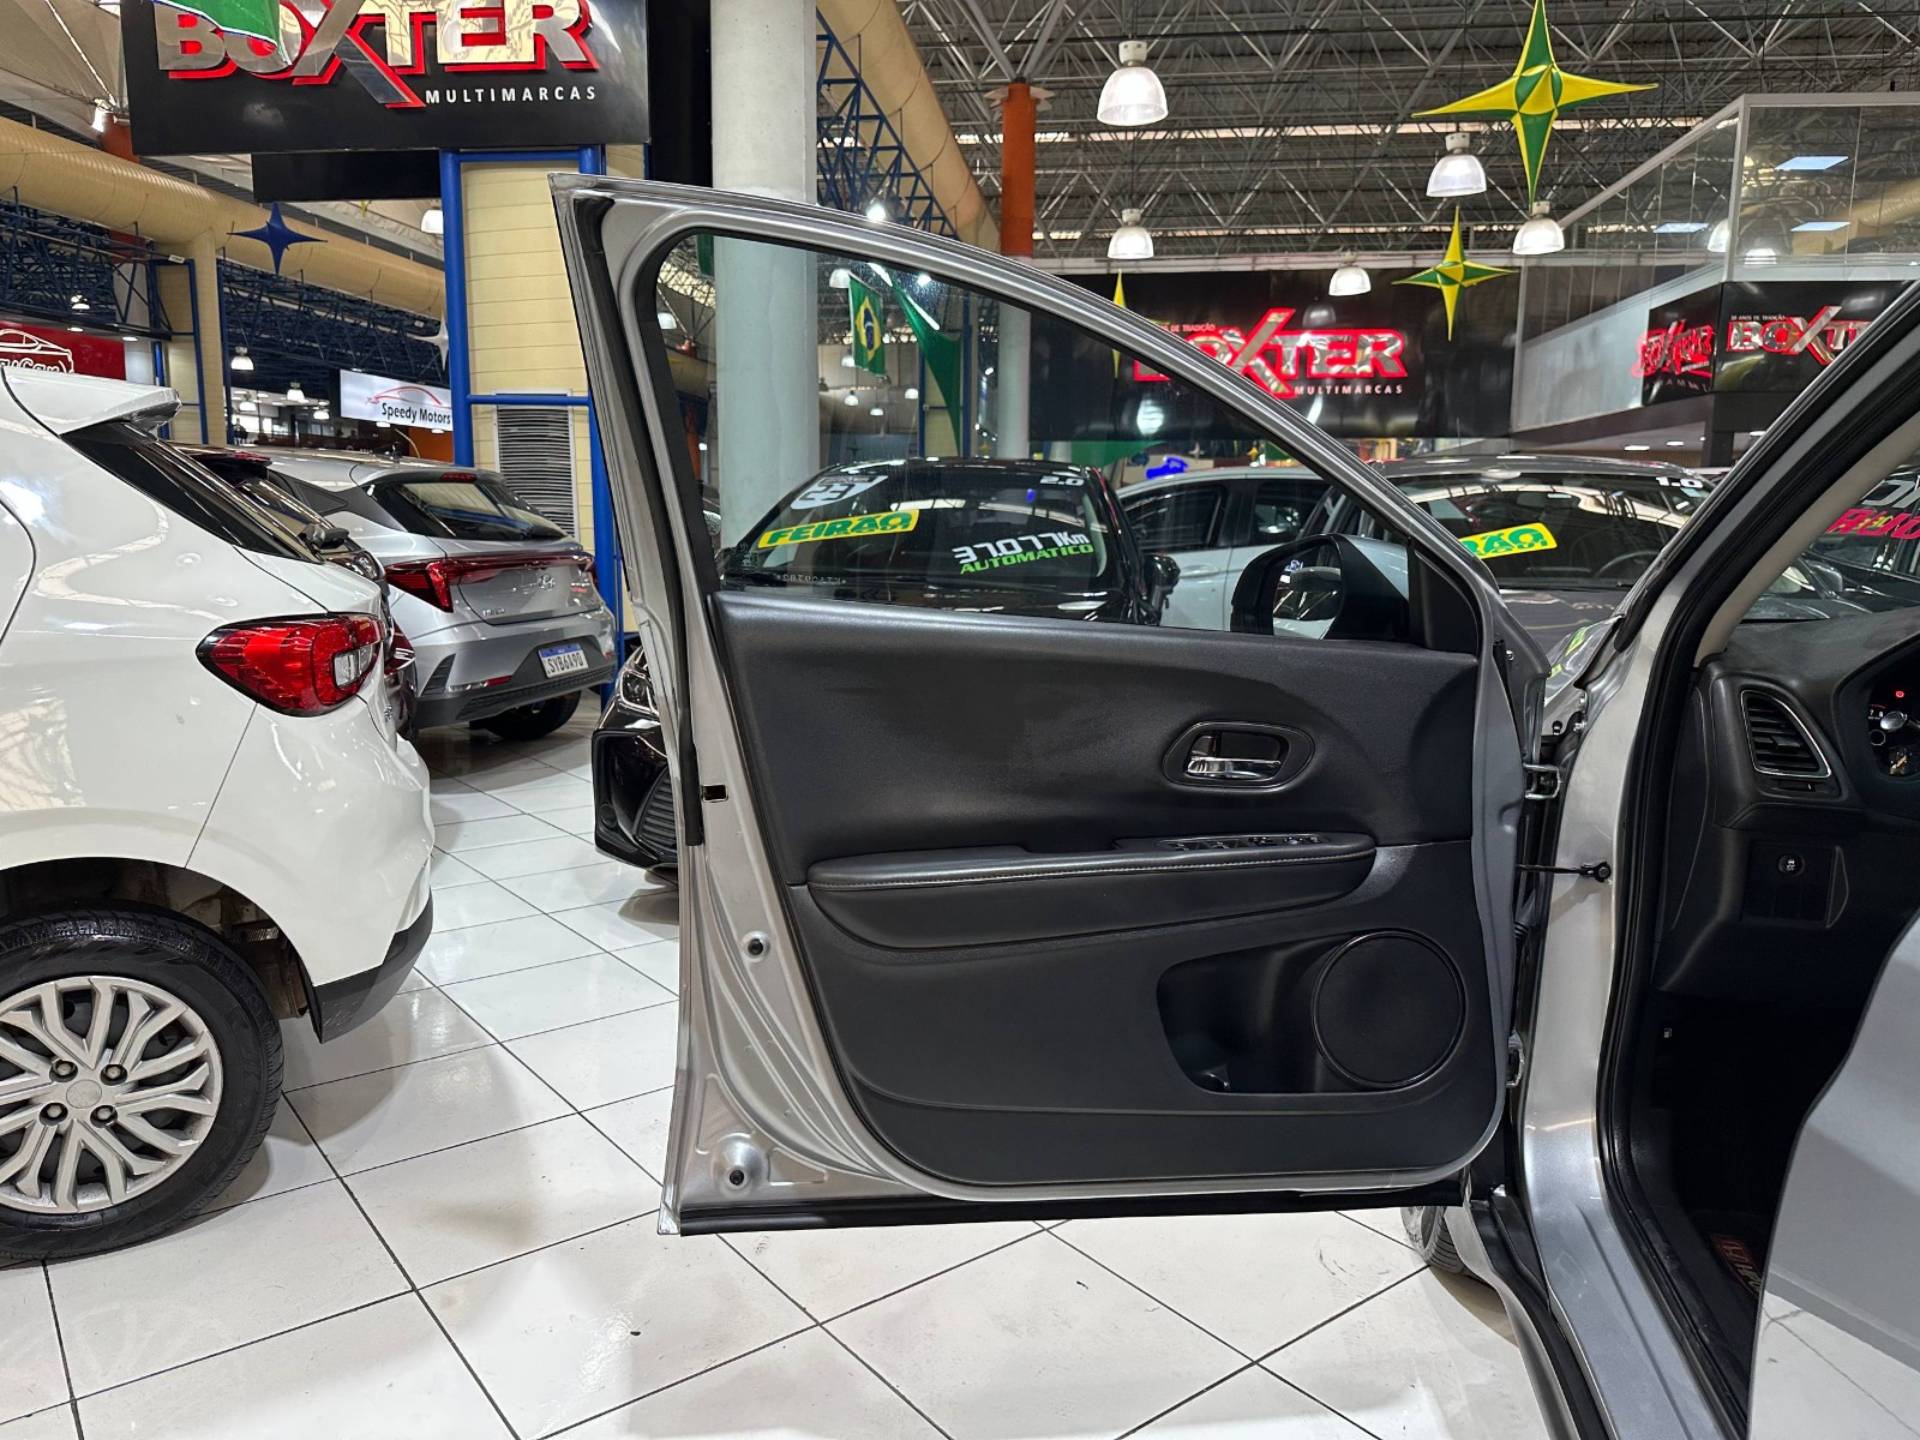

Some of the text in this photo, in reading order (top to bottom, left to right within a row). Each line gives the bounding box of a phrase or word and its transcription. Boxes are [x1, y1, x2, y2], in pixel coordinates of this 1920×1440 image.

[425, 86, 597, 105] MULTIMARCAS
[1294, 384, 1403, 395] MULTIMARCAS
[381, 402, 451, 425] Speedy Motors
[1039, 475, 1085, 487] 2.0
[1655, 476, 1704, 489] 1.0
[767, 512, 912, 545] FEIRÃO
